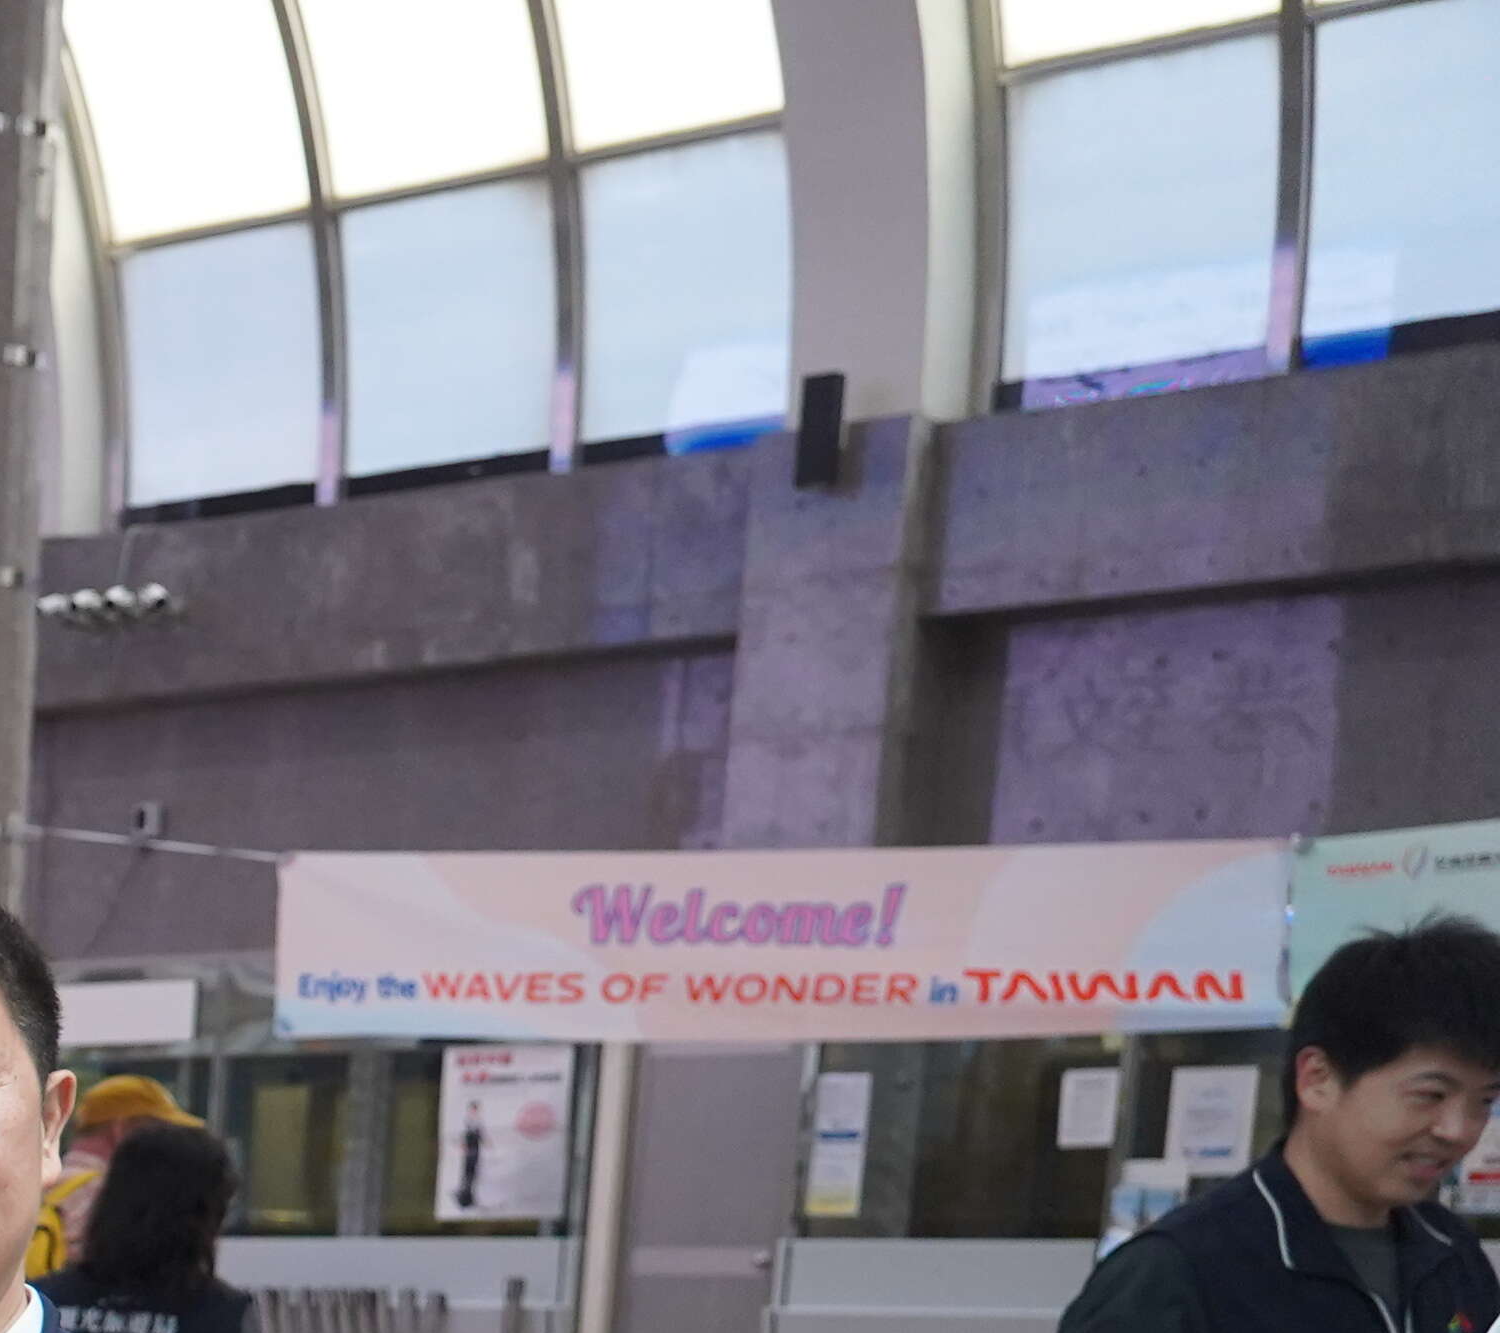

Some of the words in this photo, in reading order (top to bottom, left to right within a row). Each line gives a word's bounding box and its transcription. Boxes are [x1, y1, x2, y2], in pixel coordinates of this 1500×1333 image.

[570, 881, 908, 945] Welcome!
[297, 971, 368, 1007] Enjoy
[376, 973, 417, 1000] the
[420, 970, 585, 1004] WAVES
[599, 972, 670, 1005] OF
[684, 972, 920, 1006] WONDER
[928, 975, 960, 1005] in
[962, 968, 1244, 1004] TAIWAN
